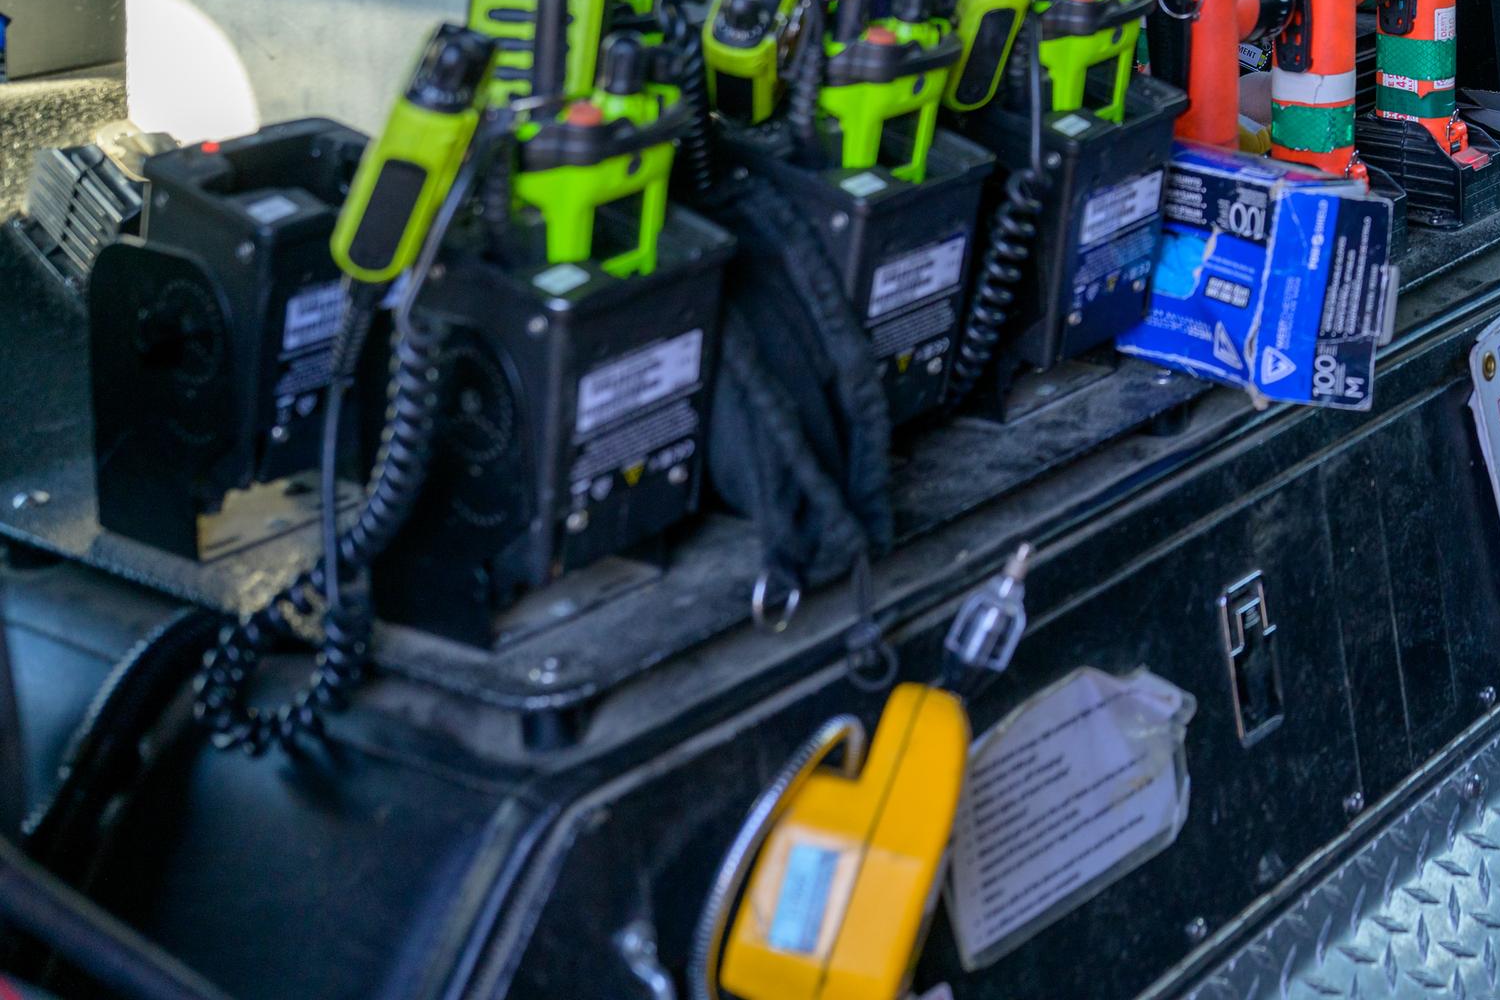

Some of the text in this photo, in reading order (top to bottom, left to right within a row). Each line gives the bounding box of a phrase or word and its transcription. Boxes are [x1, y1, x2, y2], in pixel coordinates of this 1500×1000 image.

[1239, 45, 1257, 59] MENT
[1313, 355, 1337, 397] 100
[1344, 376, 1365, 398] M
